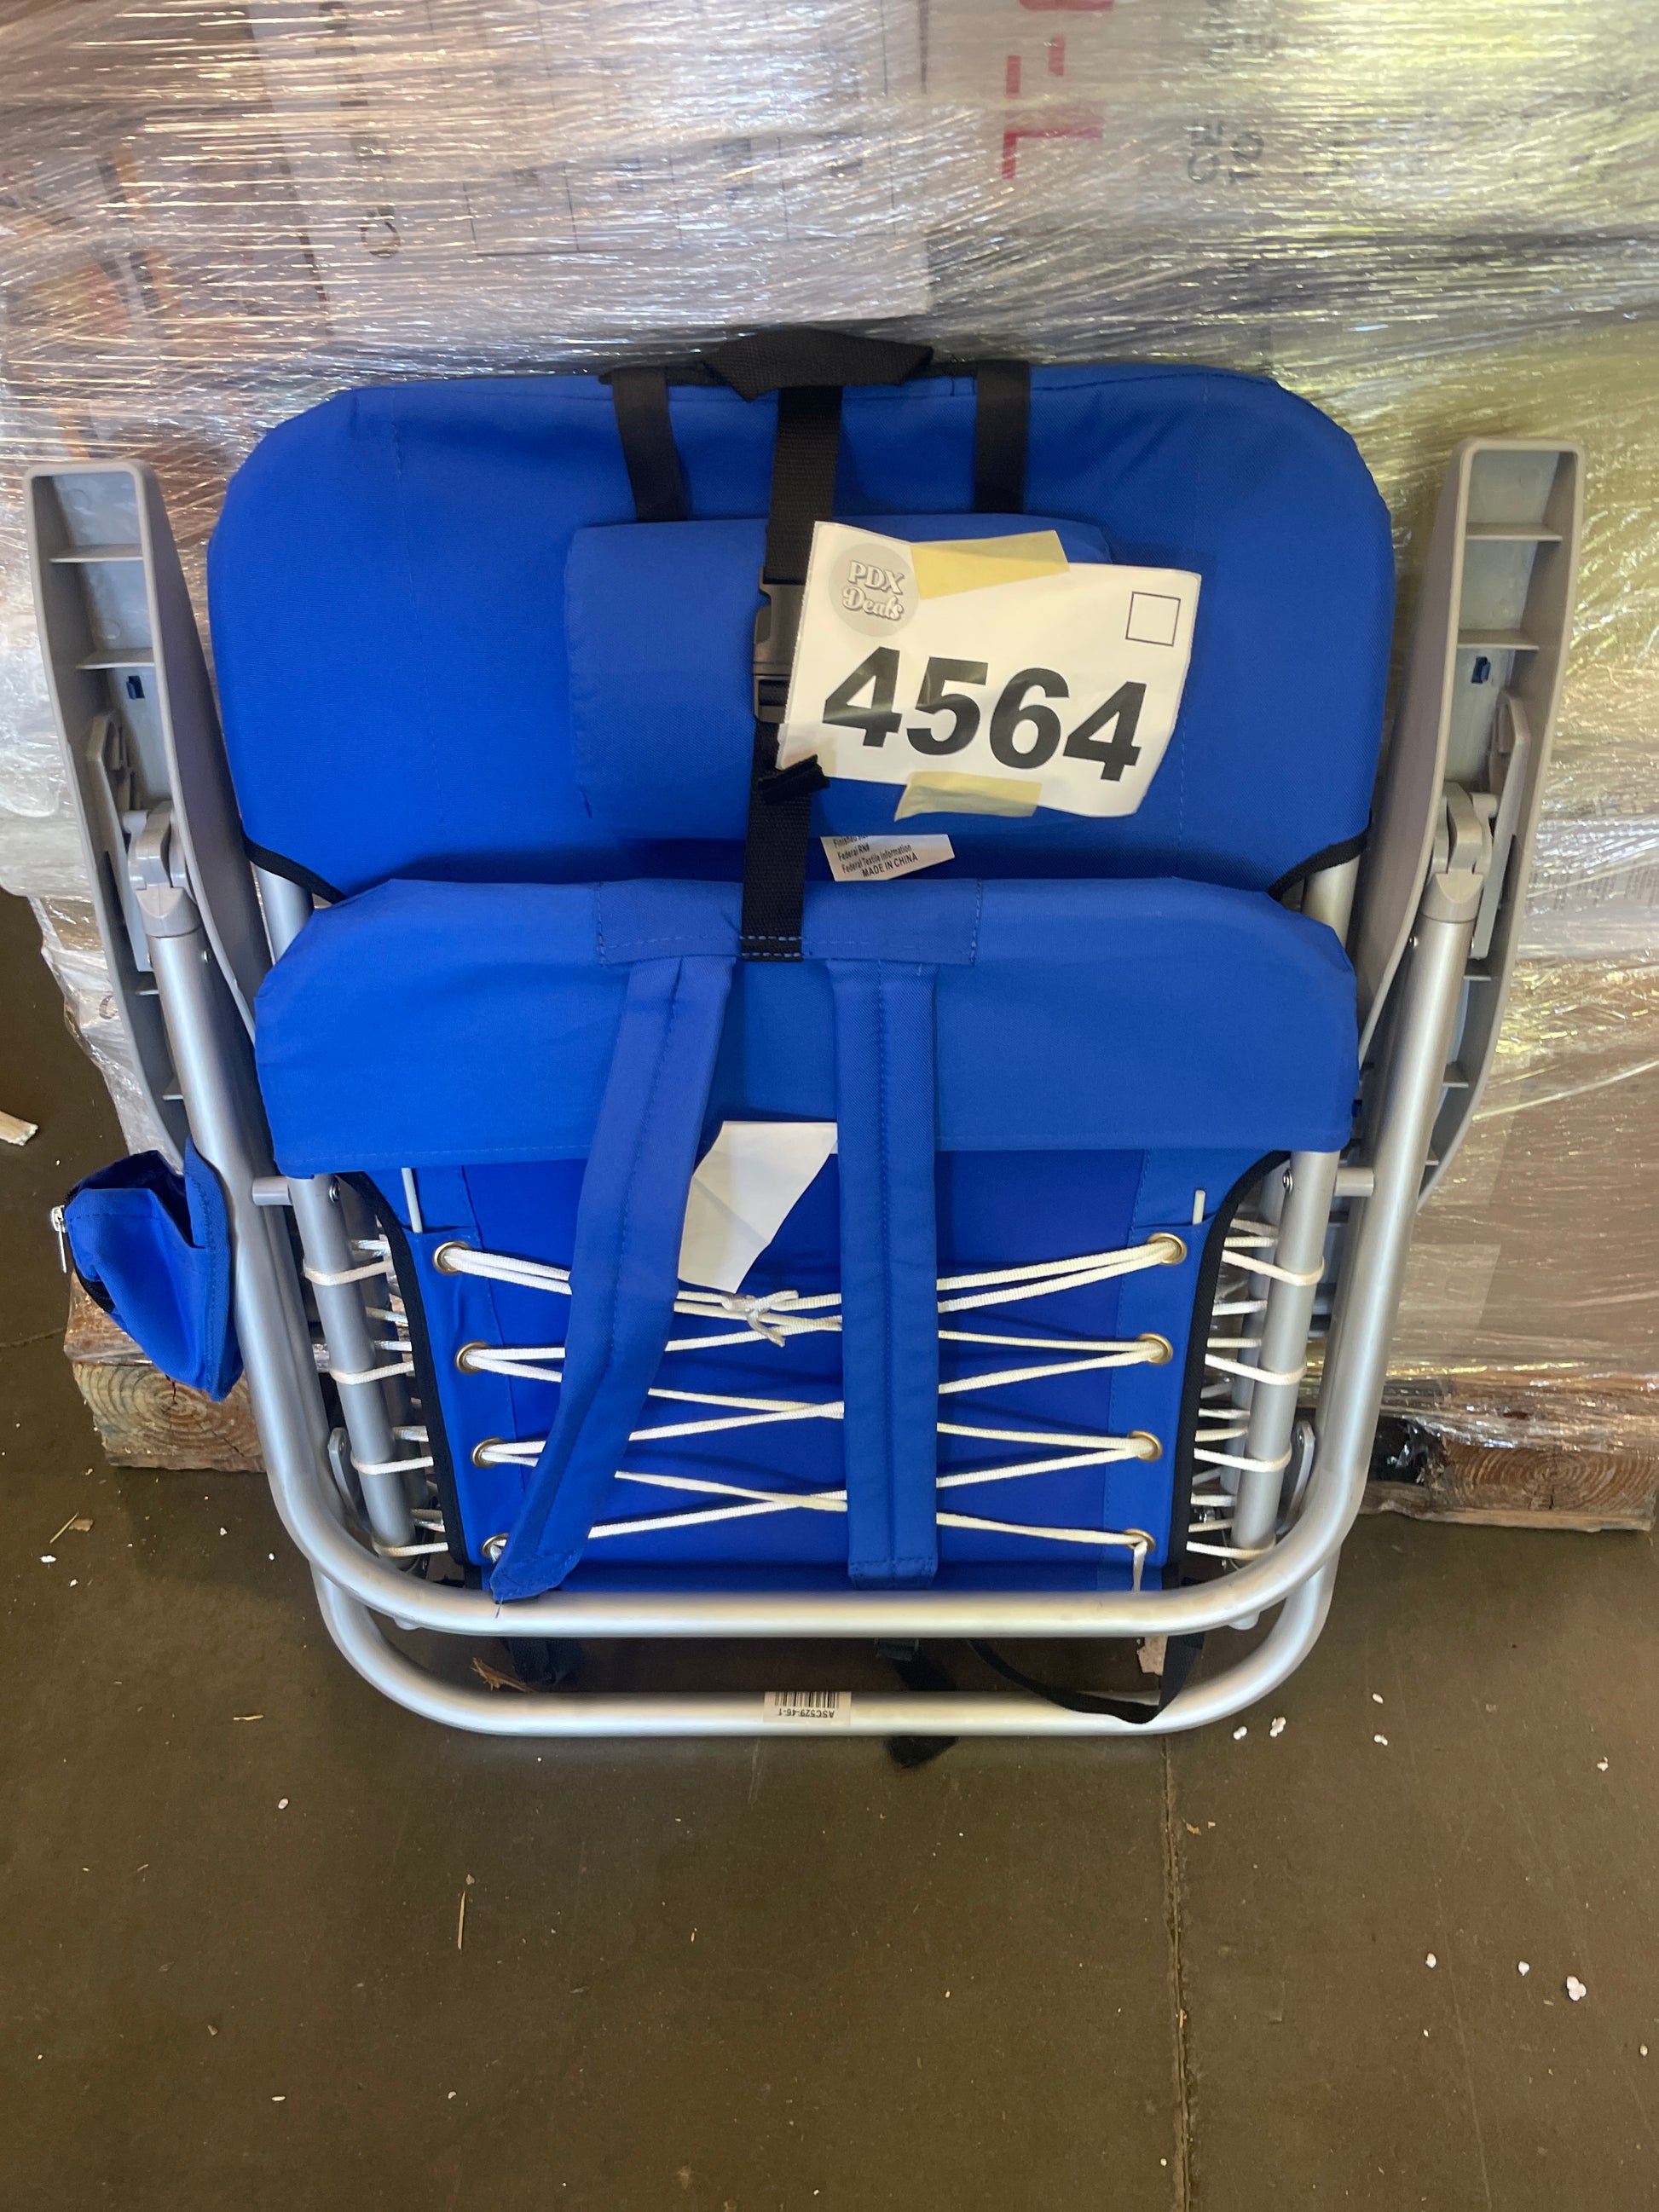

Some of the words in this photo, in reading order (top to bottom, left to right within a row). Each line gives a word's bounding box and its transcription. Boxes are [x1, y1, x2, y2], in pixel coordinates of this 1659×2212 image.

[847, 559, 905, 595] PDX
[841, 586, 905, 621] Deals
[823, 646, 1147, 782] 4564
[837, 847, 858, 861] Federal
[841, 860, 864, 874] Federal
[862, 854, 881, 867] Textile
[881, 843, 912, 860] Information
[862, 863, 884, 877] MADE
[885, 859, 893, 869] IN
[893, 852, 918, 867] CHINA
[777, 1707, 835, 1718] ASC529-46-1
